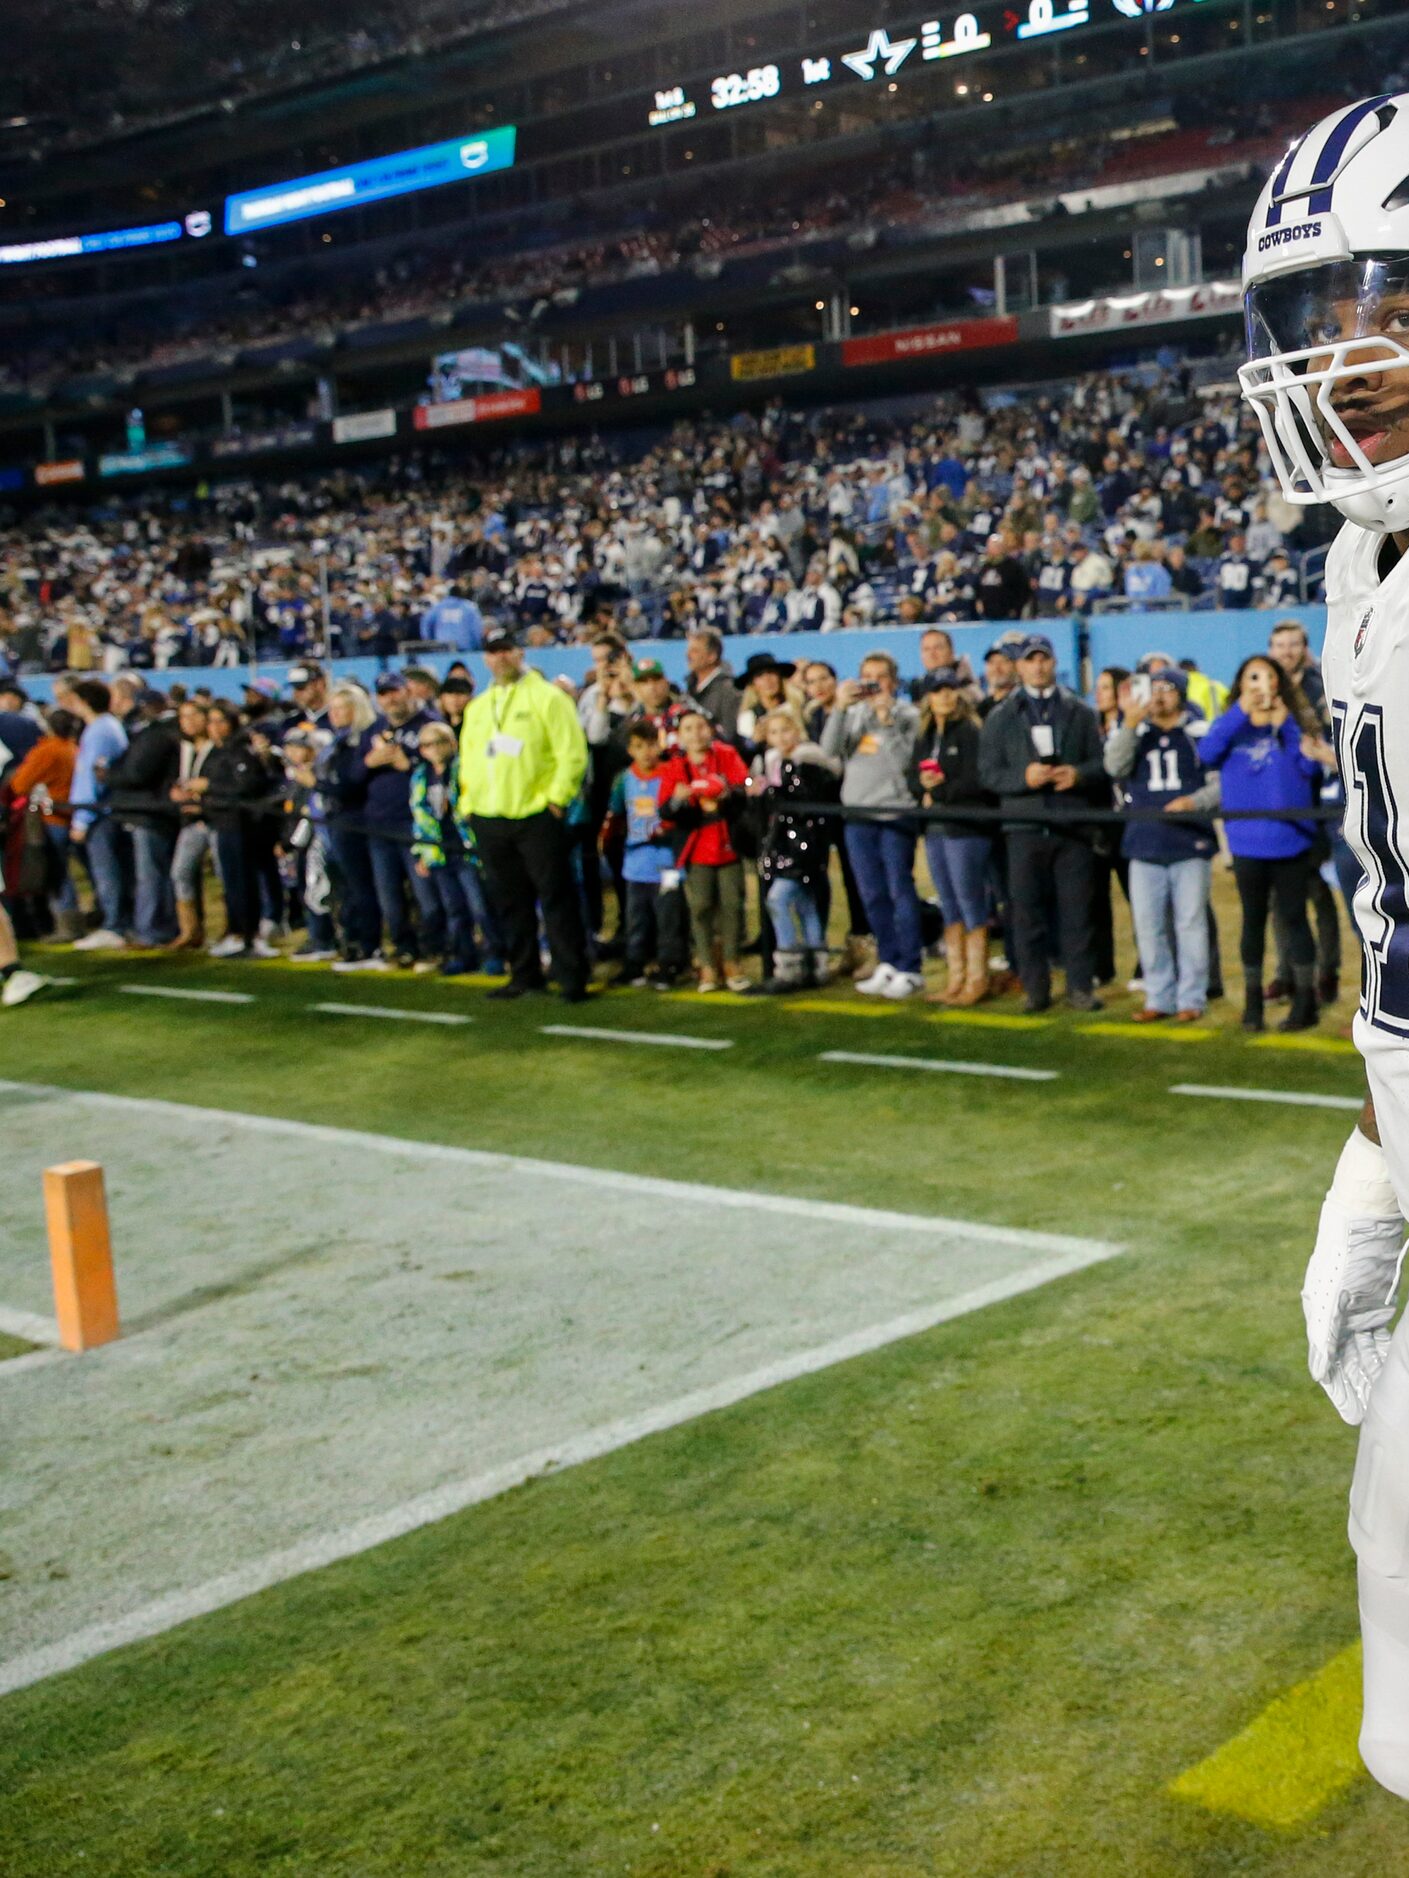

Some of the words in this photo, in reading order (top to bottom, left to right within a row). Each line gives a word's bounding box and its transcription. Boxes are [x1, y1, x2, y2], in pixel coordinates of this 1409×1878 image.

[954, 13, 978, 42] 0
[711, 64, 780, 109] 32:58
[1258, 221, 1322, 252] COWBOYS
[895, 331, 962, 352] NISSAN
[1146, 749, 1182, 792] 11
